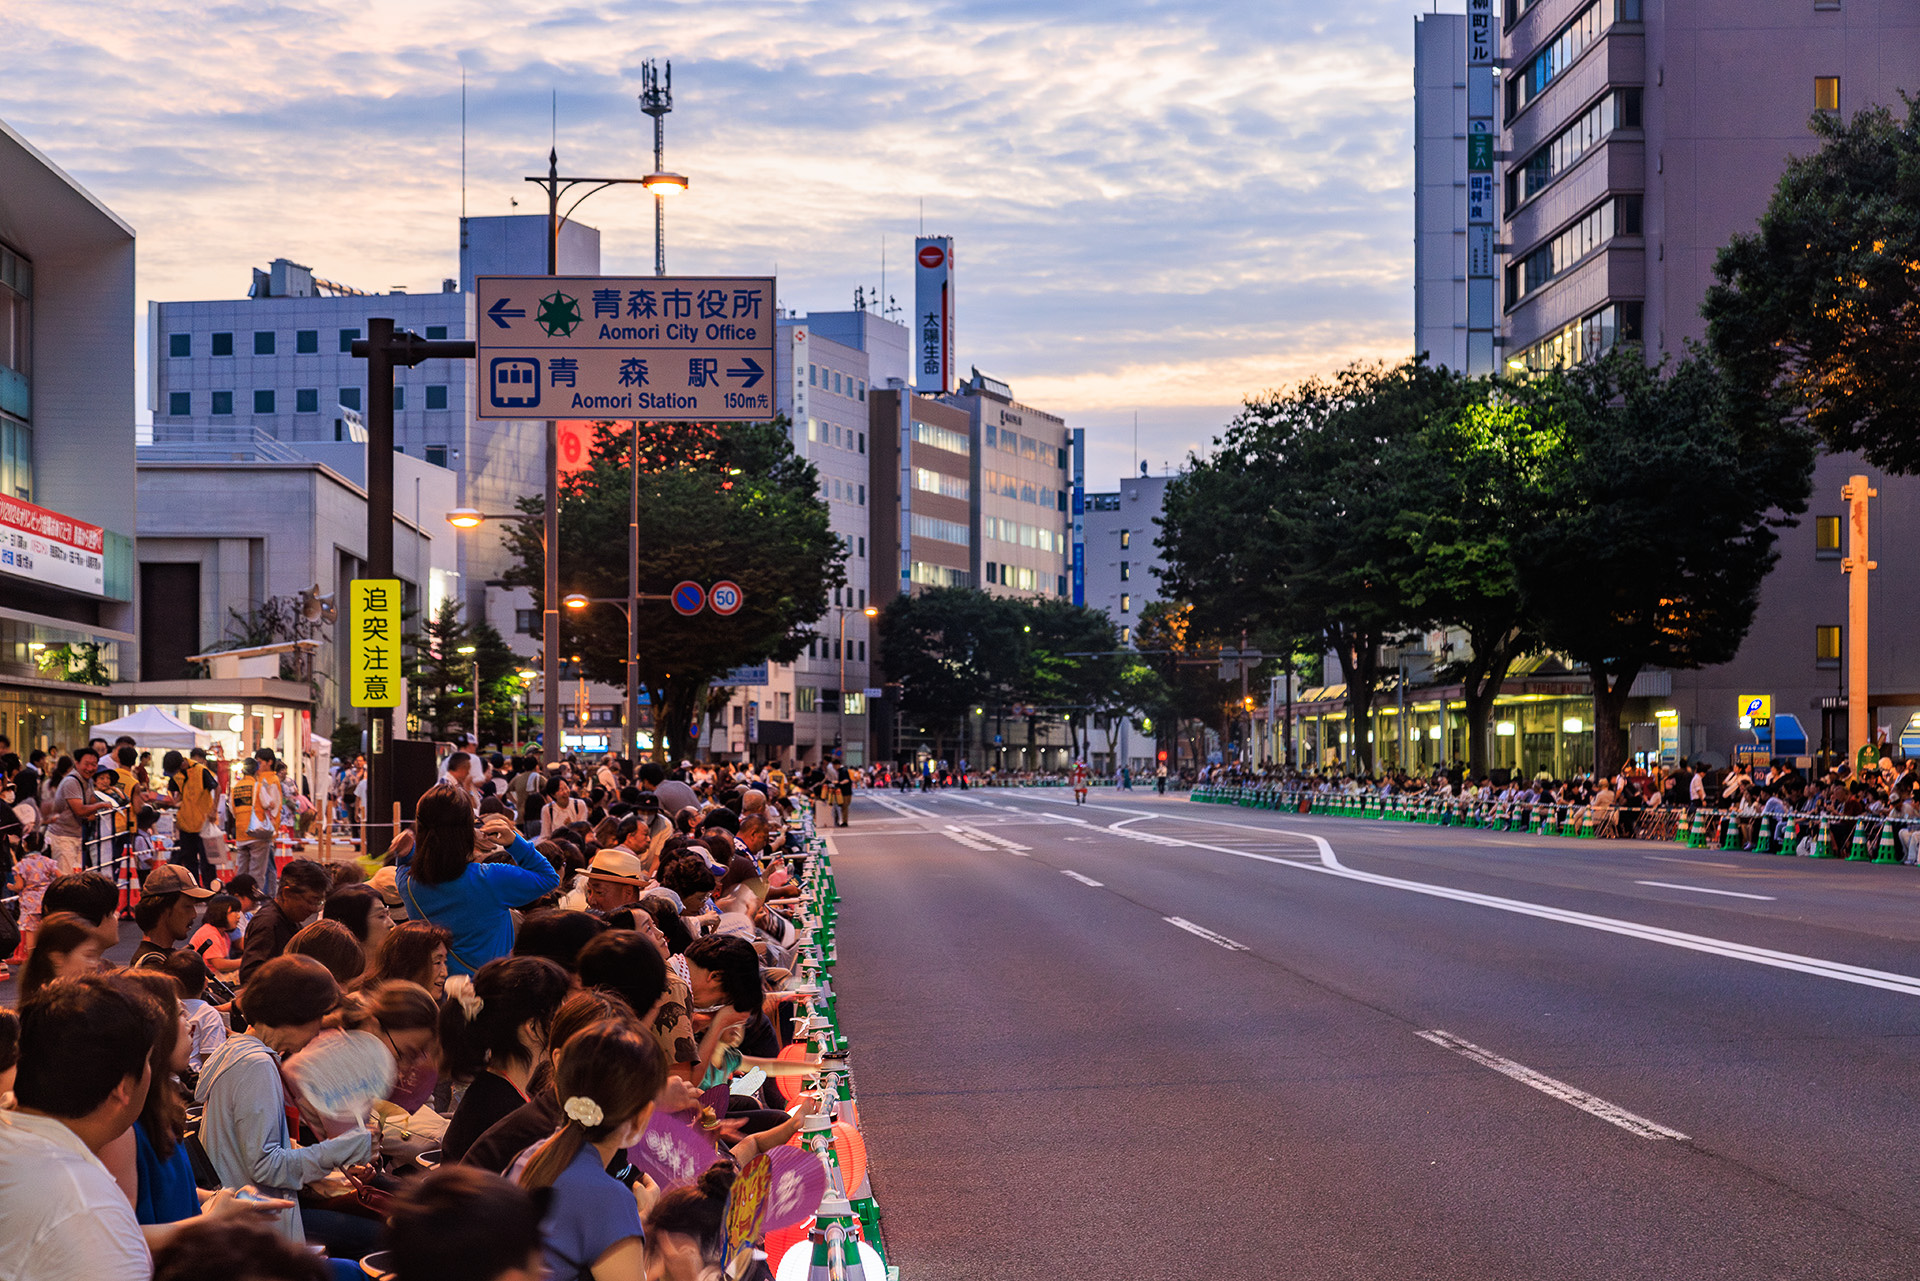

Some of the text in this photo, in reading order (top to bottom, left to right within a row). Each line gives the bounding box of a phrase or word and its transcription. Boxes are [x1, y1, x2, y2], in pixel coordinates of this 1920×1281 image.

[592, 288, 763, 319] 青森市役所
[598, 323, 757, 343] Aomori City Office
[923, 312, 940, 375] 太陽生命
[571, 392, 698, 408] Aomori Station
[723, 393, 769, 409] 150m先
[716, 590, 735, 606] 50
[363, 587, 389, 700] 追突注意
